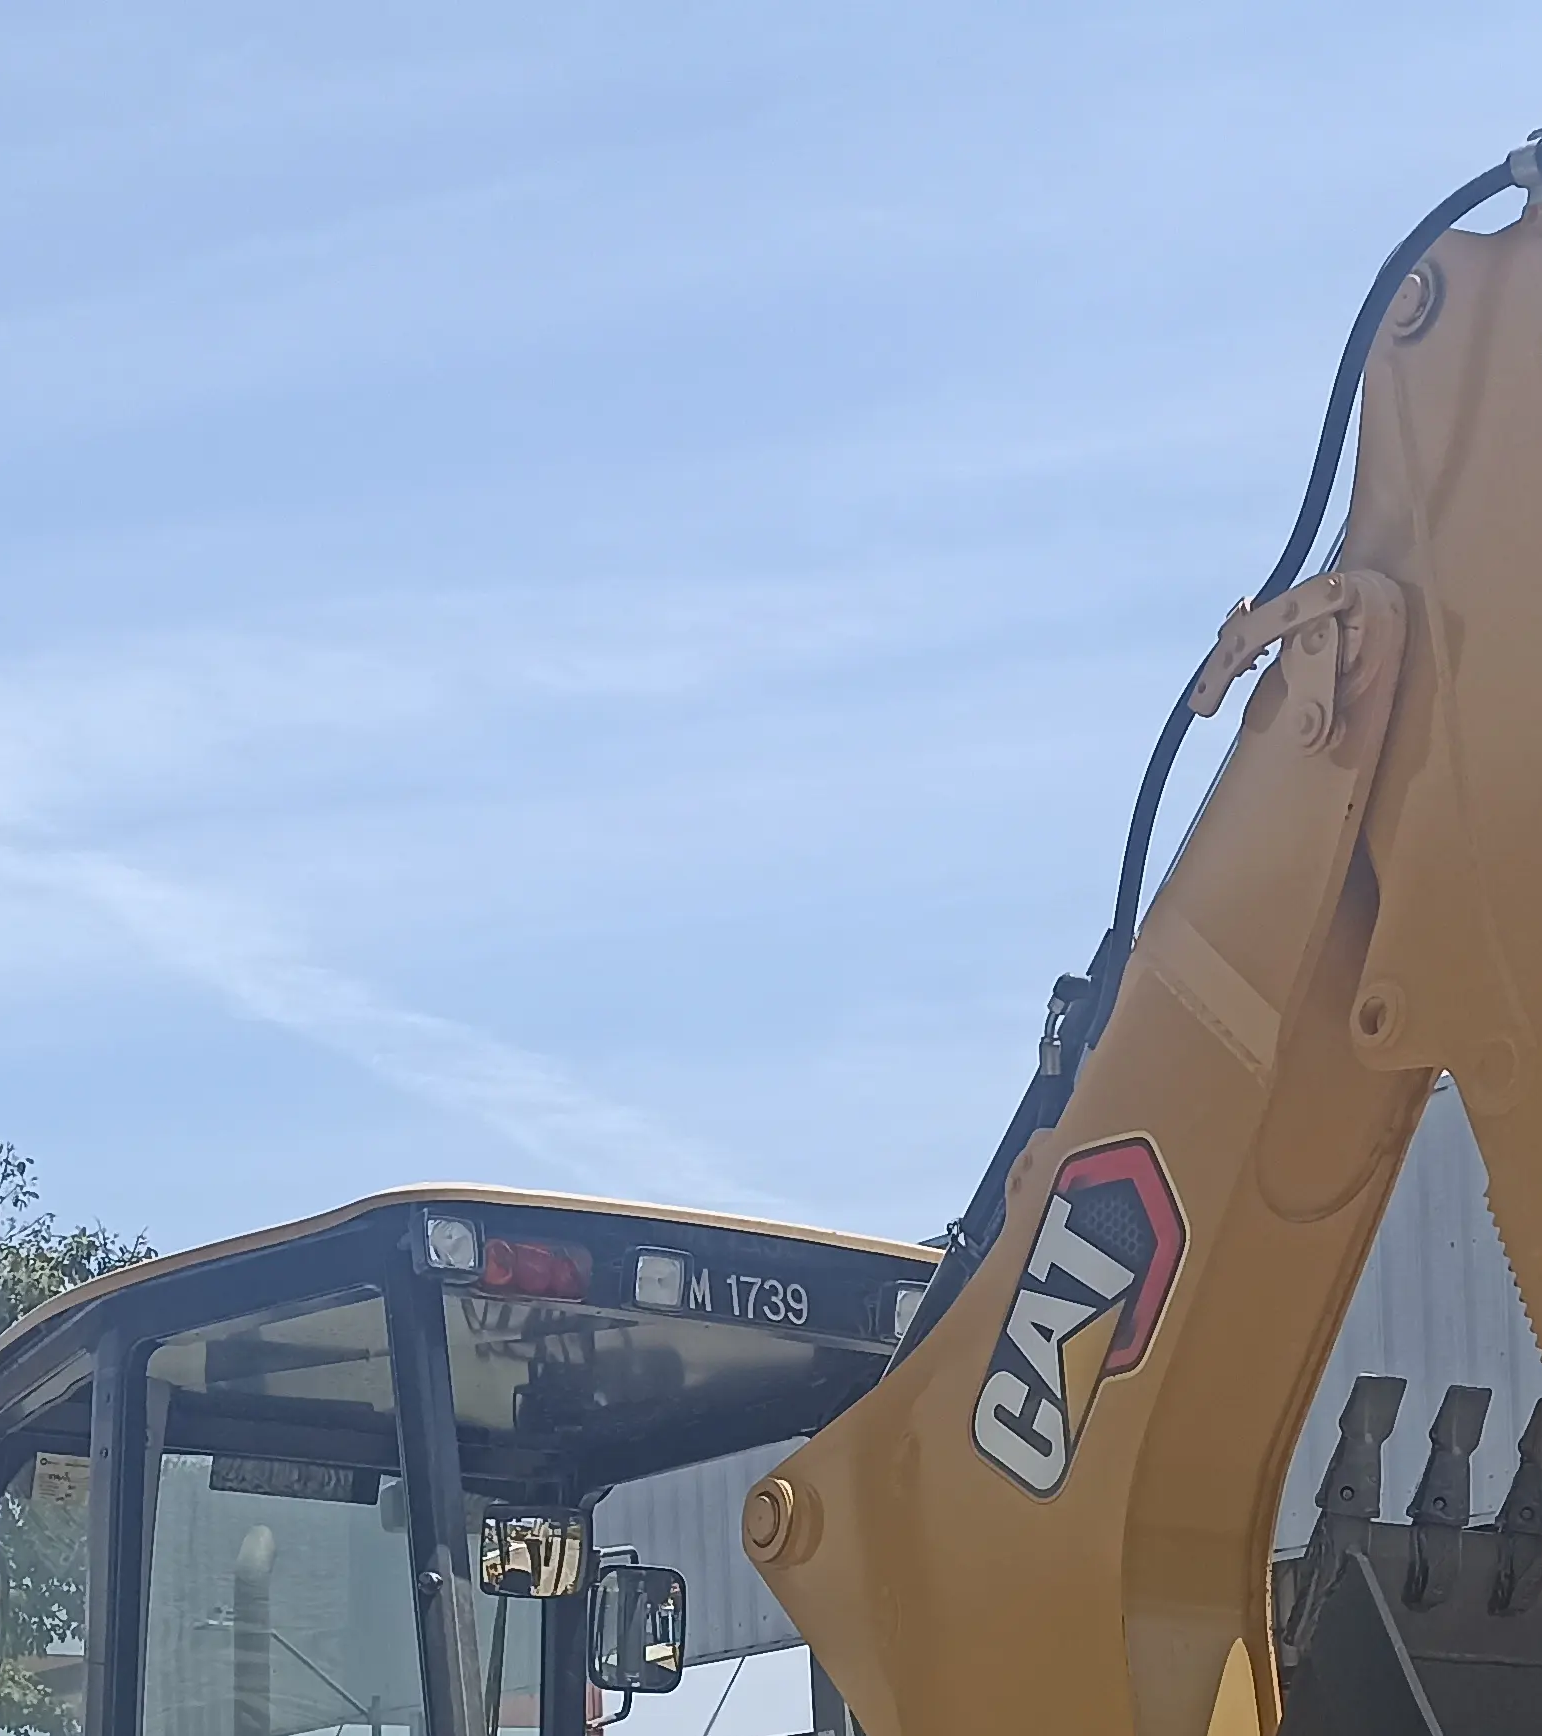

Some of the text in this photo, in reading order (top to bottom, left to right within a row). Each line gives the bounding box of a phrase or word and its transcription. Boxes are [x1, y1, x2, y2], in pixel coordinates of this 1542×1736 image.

[689, 1268, 808, 1325] M 1739
[974, 1195, 1135, 1490] CAT
